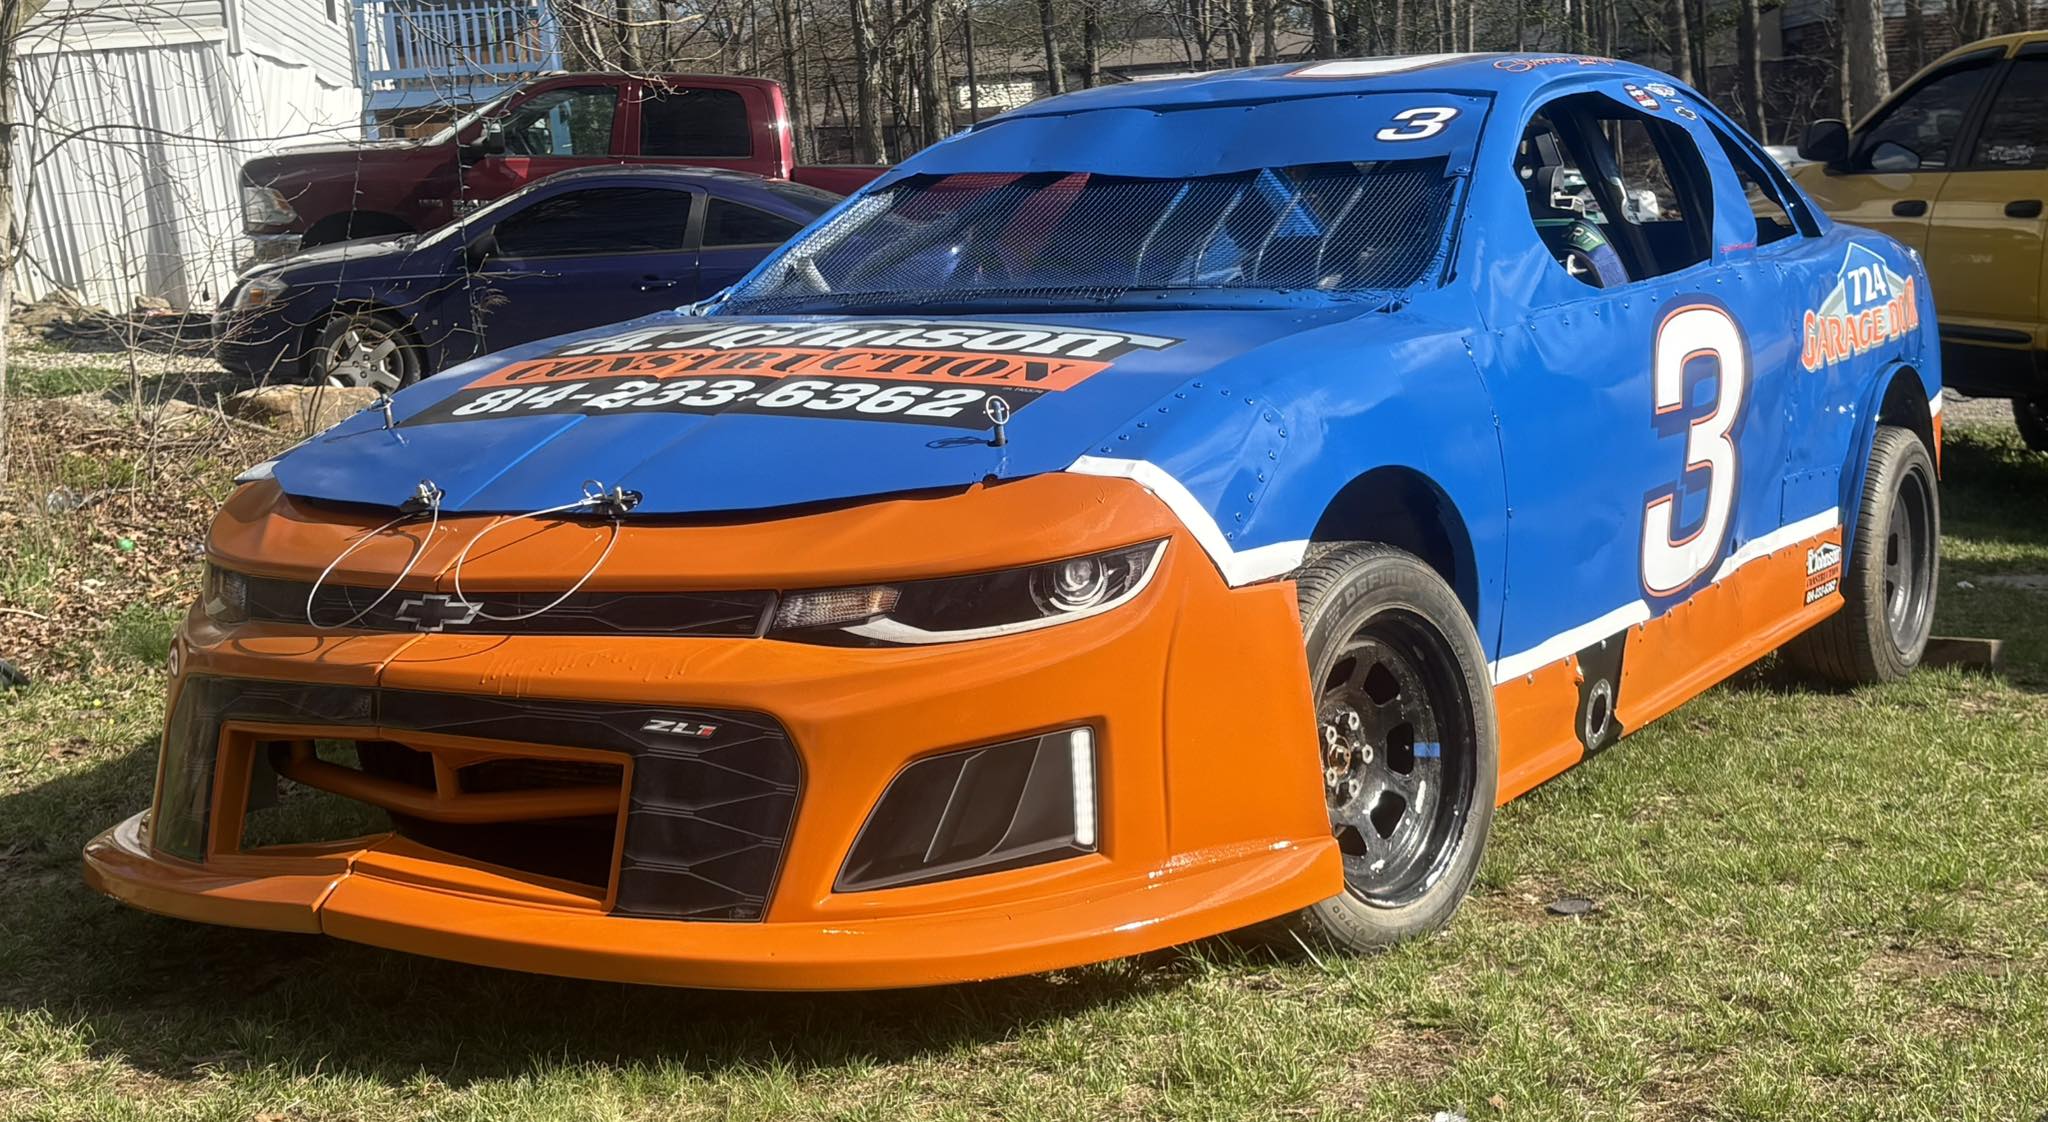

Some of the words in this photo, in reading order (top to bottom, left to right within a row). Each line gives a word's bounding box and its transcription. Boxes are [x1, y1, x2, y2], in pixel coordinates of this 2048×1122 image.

[1375, 106, 1460, 142] 3
[1847, 263, 1888, 306] 724
[1801, 308, 1888, 373] GARAGE
[506, 352, 1074, 382] CONSTRUCTION
[452, 380, 986, 417] 814-233-6362
[1641, 303, 1748, 600] 3
[643, 719, 717, 736] ZL1
